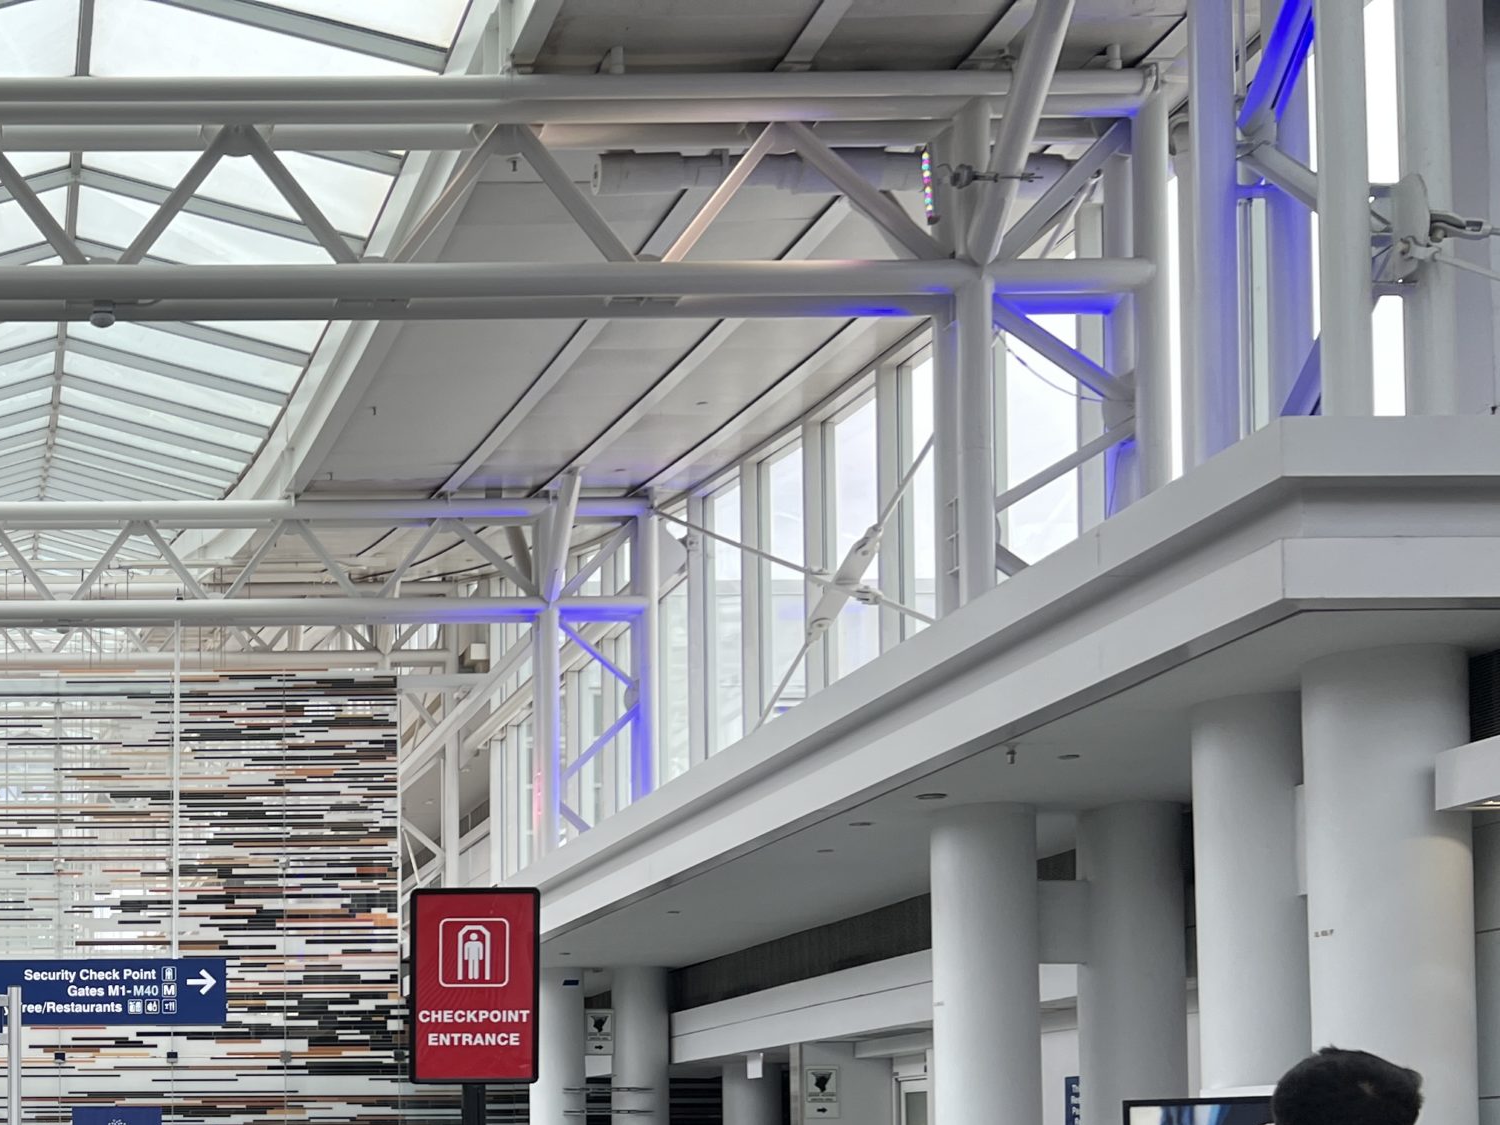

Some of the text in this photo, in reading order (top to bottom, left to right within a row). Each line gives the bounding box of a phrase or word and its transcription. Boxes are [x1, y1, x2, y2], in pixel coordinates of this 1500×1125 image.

[23, 968, 157, 983] Security Check Point
[67, 985, 105, 998] Gates
[20, 1000, 123, 1014] ree/Restaurants
[418, 1009, 530, 1023] CHECKPOINT
[427, 1033, 520, 1046] ENTRANCE
